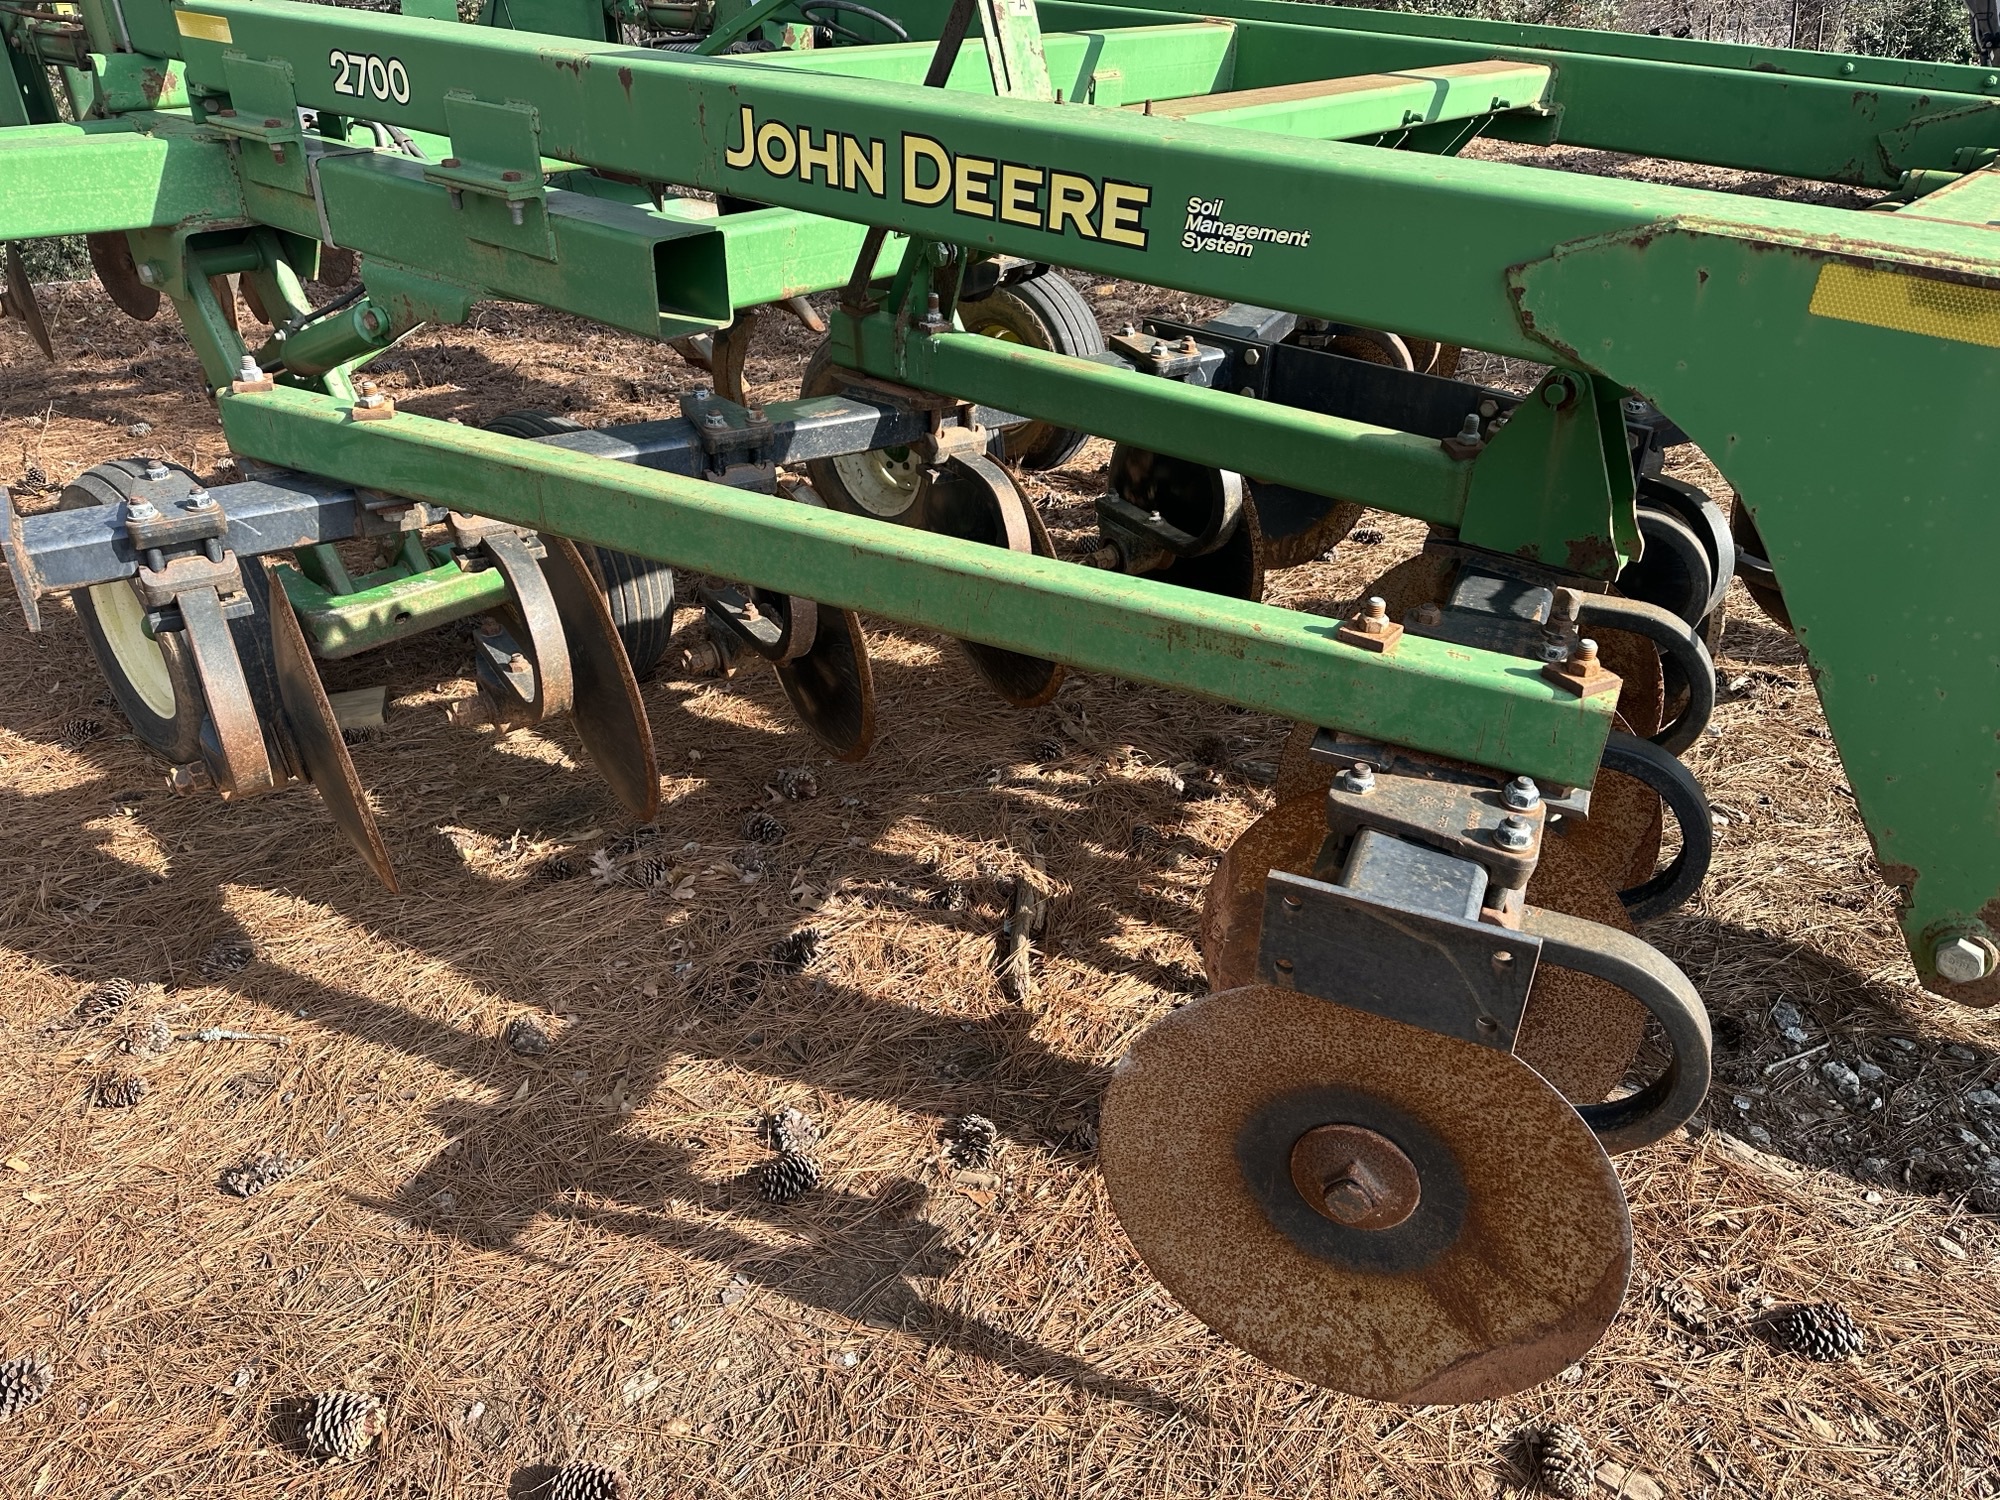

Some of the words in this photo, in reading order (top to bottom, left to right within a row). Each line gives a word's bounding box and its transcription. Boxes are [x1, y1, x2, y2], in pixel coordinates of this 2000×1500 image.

[330, 50, 410, 104] 2700
[726, 105, 886, 197] JOHN
[902, 132, 1150, 249] DEERE
[1186, 196, 1224, 217] Soil
[1181, 231, 1254, 257] System
[1184, 213, 1311, 248] Management
